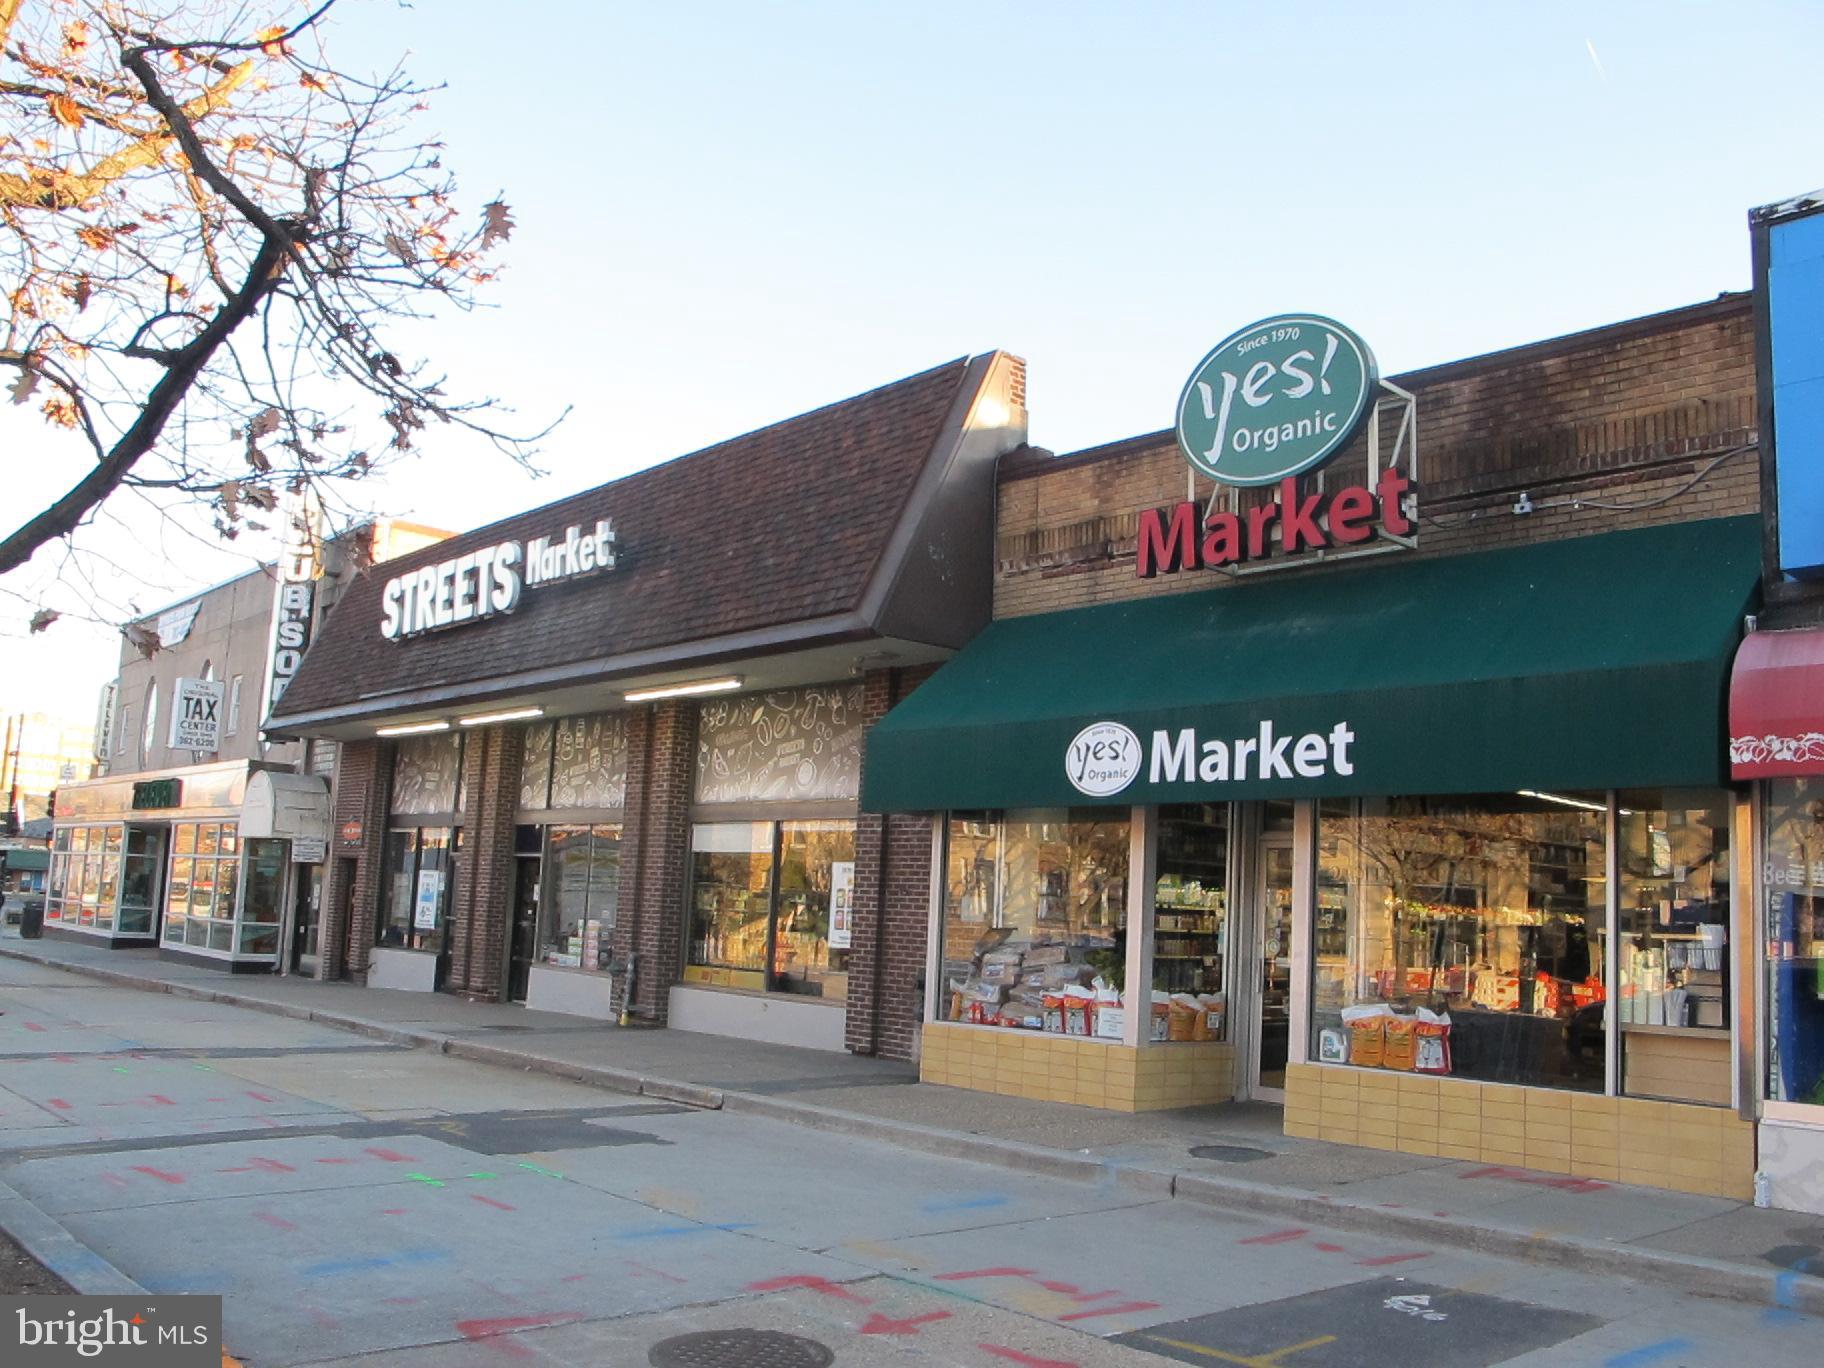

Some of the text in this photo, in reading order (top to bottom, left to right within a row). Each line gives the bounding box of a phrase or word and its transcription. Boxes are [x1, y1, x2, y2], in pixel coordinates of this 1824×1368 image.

[1237, 327, 1300, 357] Since 1970
[1232, 409, 1337, 453] Organic
[1136, 467, 1410, 578] Market
[381, 517, 616, 642] STREETS Market
[180, 720, 217, 732] CENTER
[183, 696, 218, 722] TAX
[1149, 720, 1355, 783] Market
[1088, 768, 1129, 781] Organic
